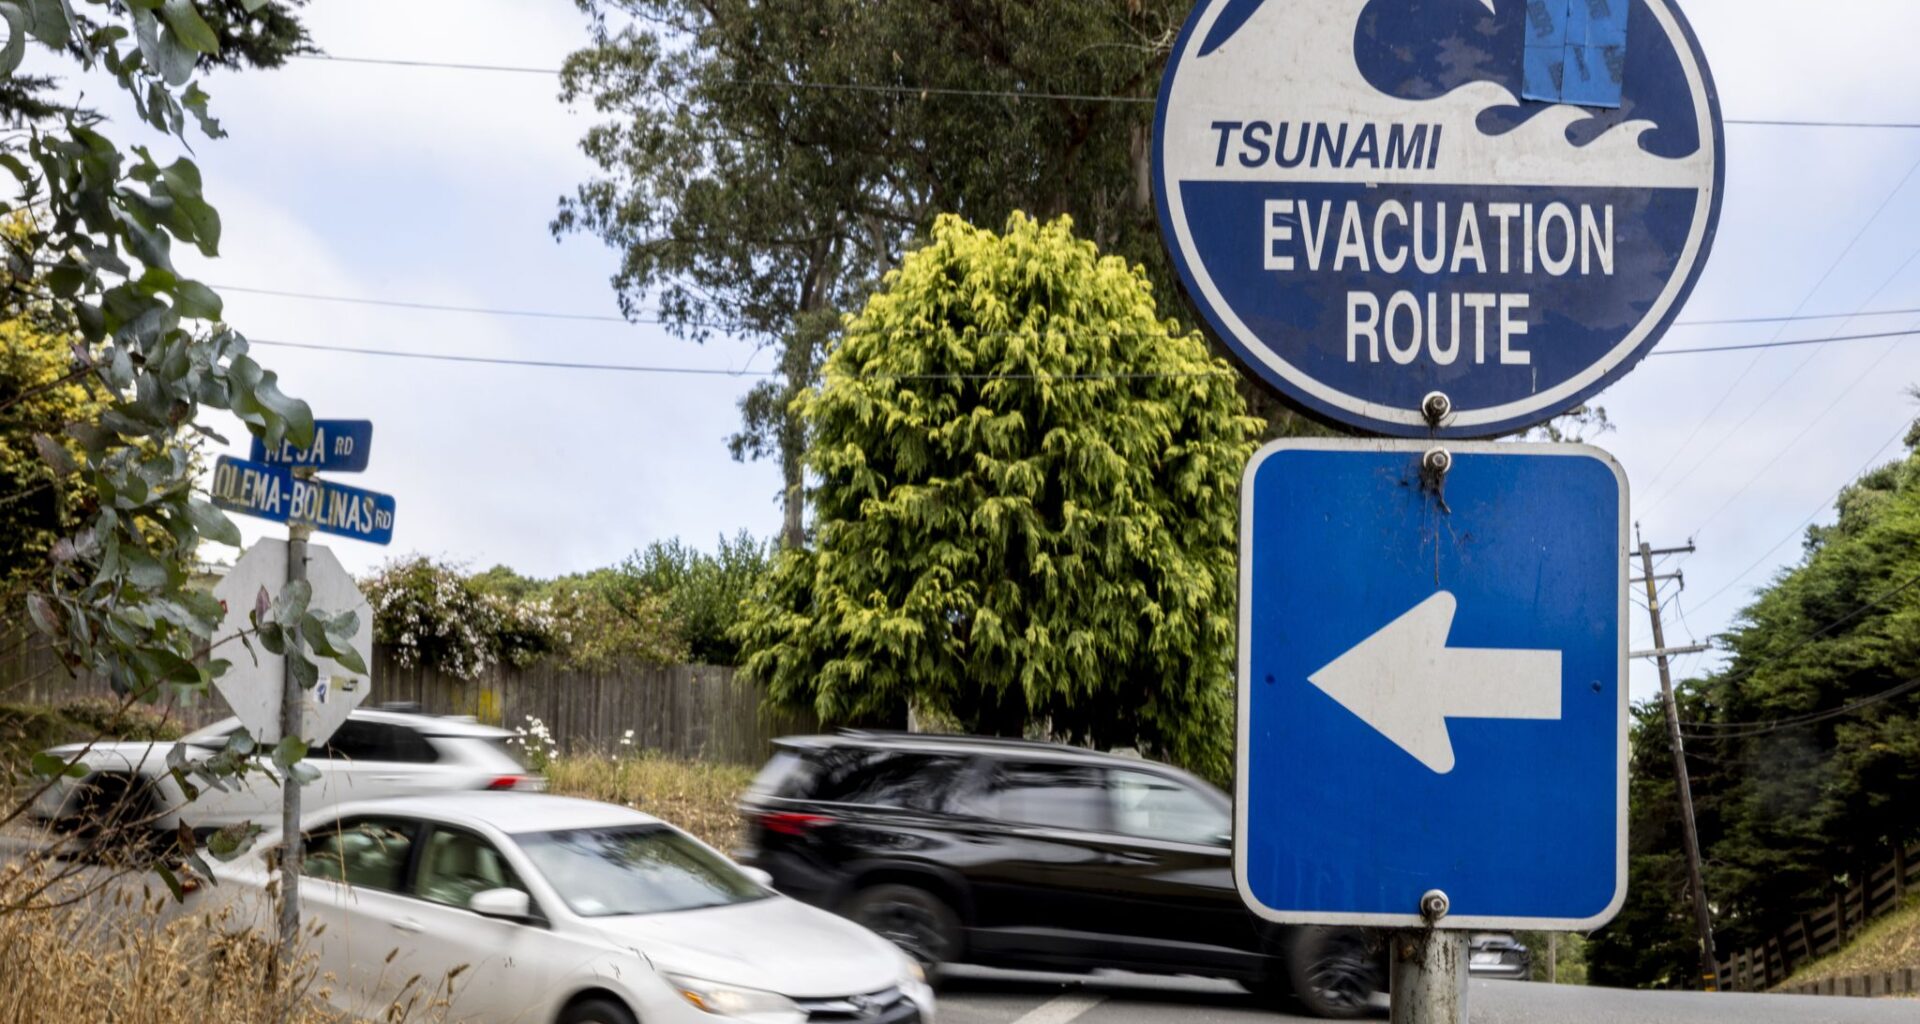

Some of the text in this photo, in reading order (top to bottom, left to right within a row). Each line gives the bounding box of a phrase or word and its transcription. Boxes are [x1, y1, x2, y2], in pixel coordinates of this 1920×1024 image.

[1210, 121, 1442, 170] TSUNAMI
[1263, 199, 1614, 276] EVACUATION
[1346, 291, 1531, 366] ROUTE
[334, 436, 354, 455] RD
[215, 463, 392, 534] OLEMA-BOLINAS RD
